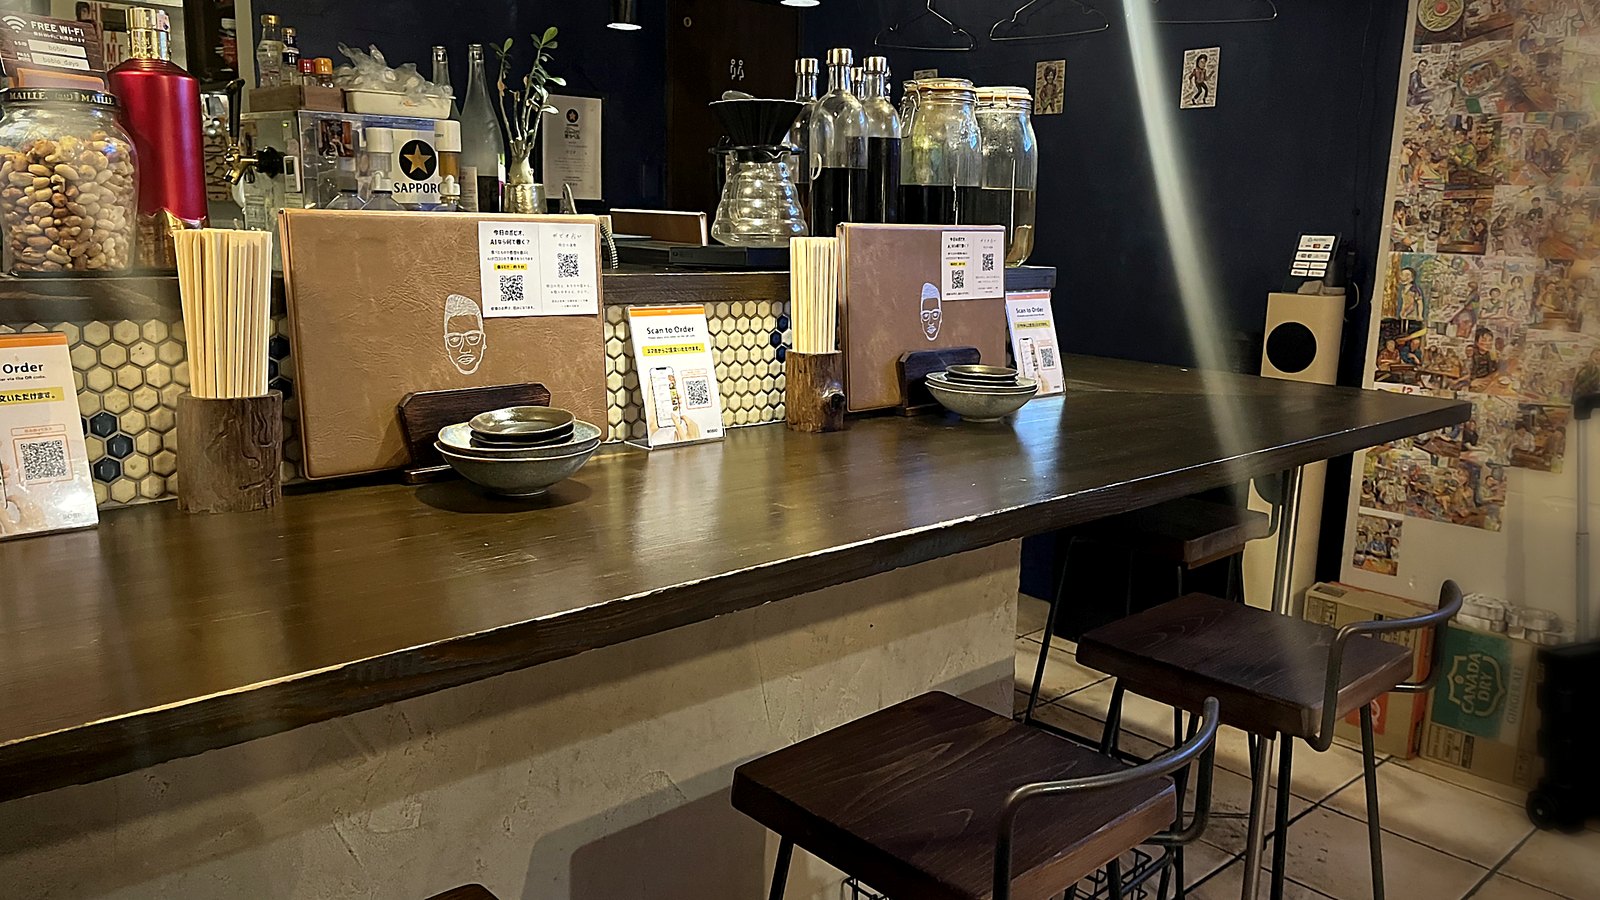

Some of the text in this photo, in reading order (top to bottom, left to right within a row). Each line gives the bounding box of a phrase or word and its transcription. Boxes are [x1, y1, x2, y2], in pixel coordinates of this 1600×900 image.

[30, 21, 84, 37] FREE WI-FI
[393, 182, 442, 194] SAPPOR
[646, 326, 664, 335] Scan
[674, 325, 694, 333] Order
[2, 362, 44, 374] Order
[1460, 653, 1483, 714] CANADA
[1477, 671, 1494, 702] DRY
